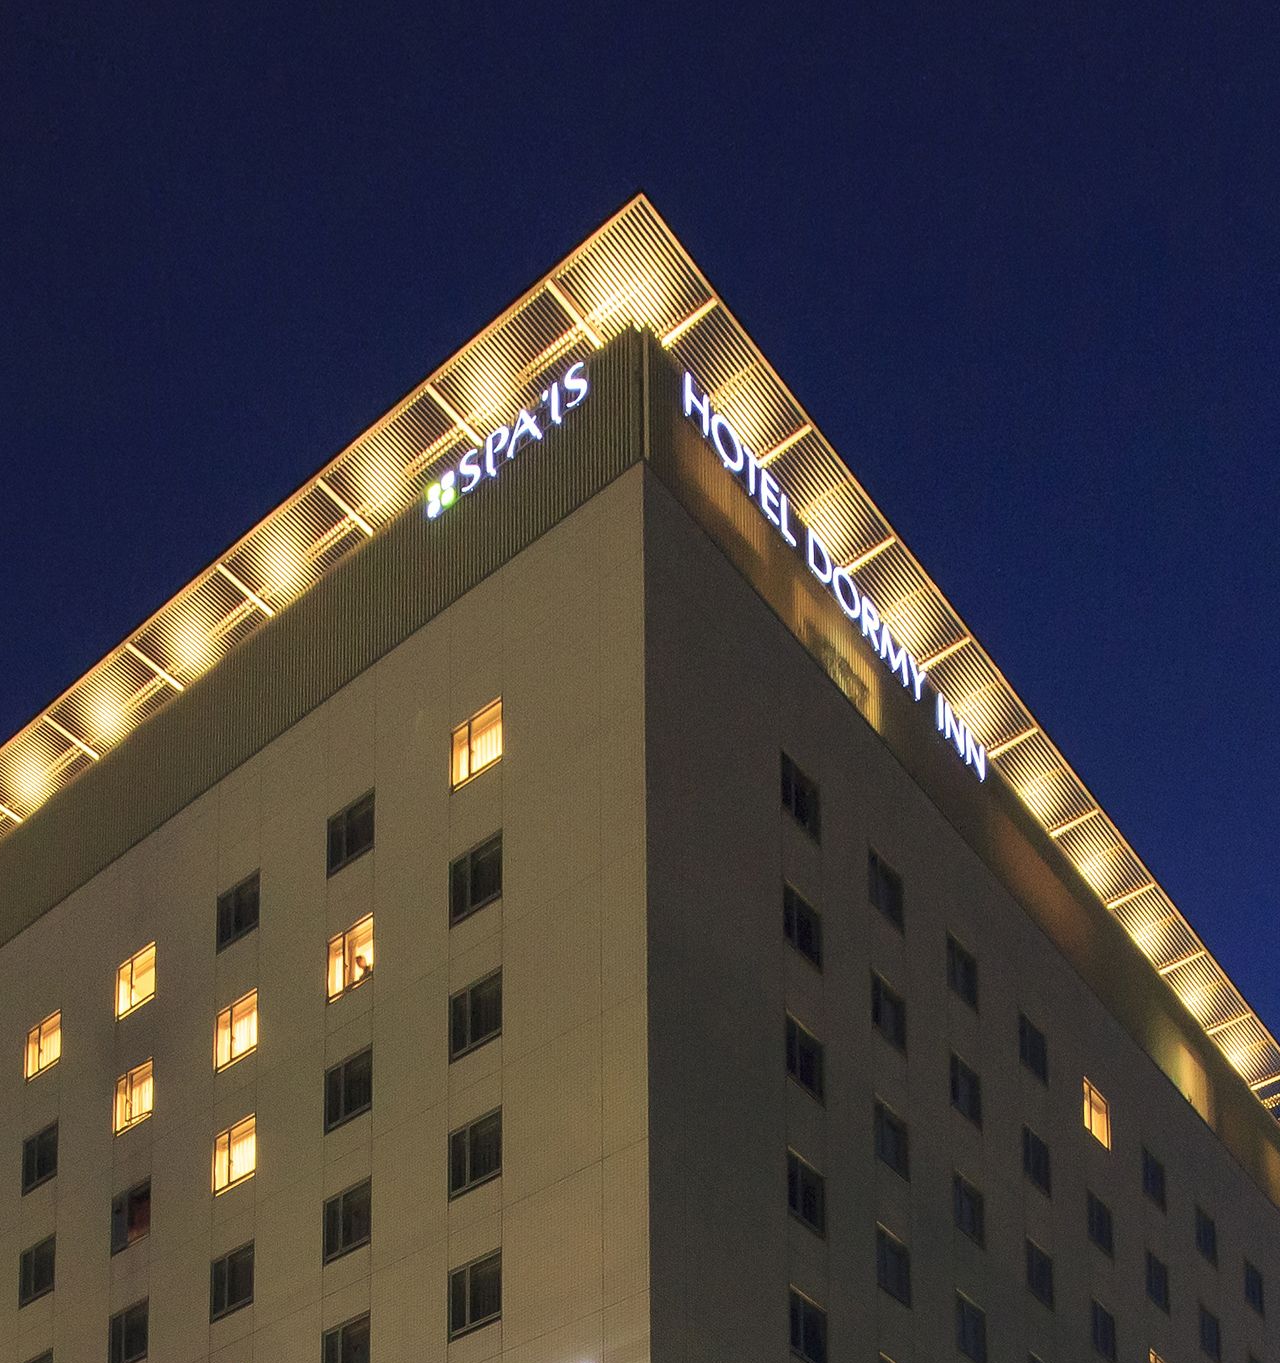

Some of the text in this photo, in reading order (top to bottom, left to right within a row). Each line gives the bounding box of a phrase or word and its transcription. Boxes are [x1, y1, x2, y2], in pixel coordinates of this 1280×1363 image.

[683, 371, 987, 782] HOTEL DORMY INN
